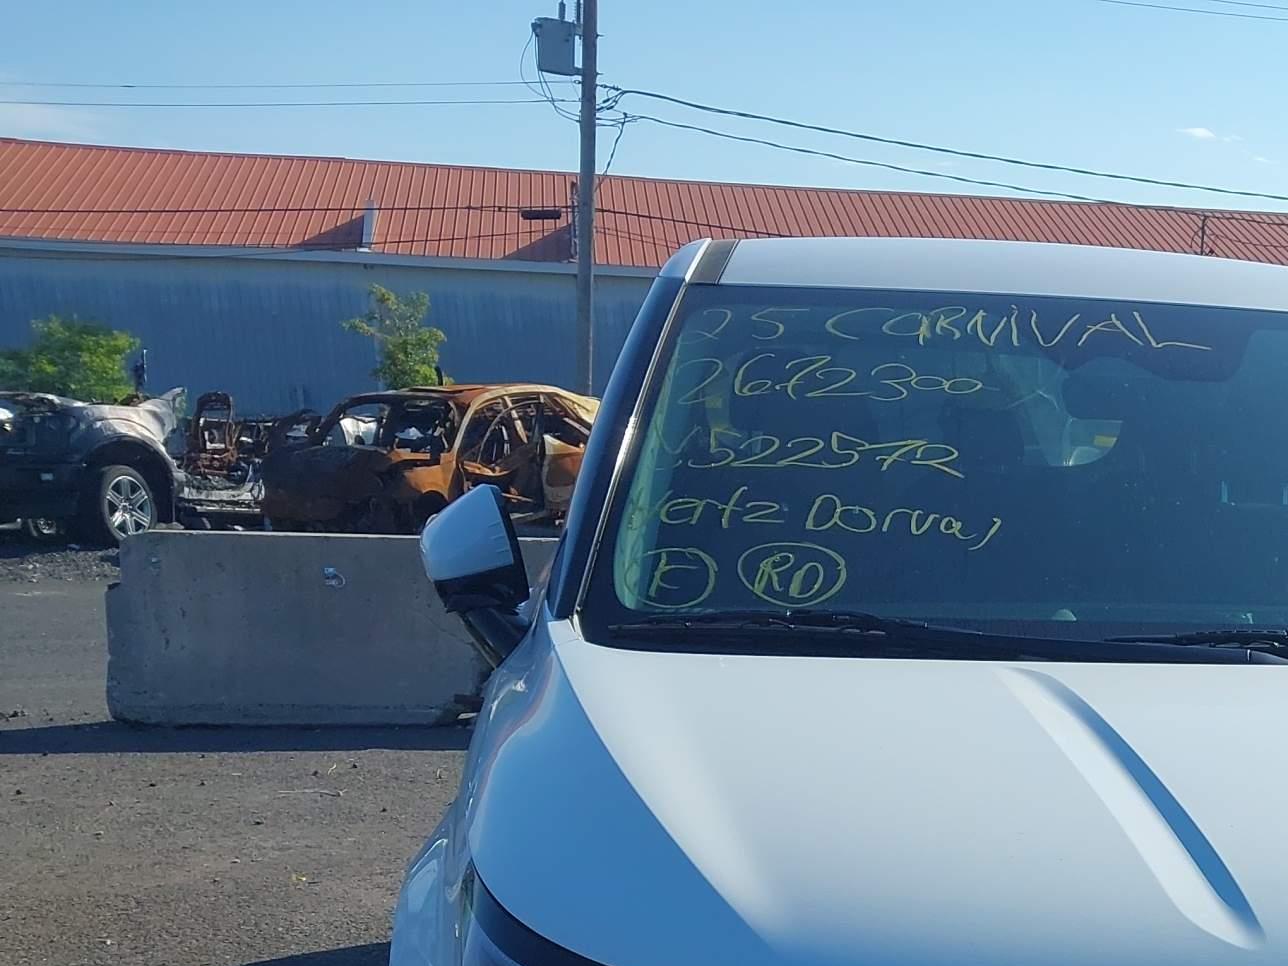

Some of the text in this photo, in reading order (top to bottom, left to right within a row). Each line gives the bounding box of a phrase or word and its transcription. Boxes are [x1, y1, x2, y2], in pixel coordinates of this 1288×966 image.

[682, 304, 1212, 350] 25 CARNIVAL
[676, 353, 985, 405] 2672300
